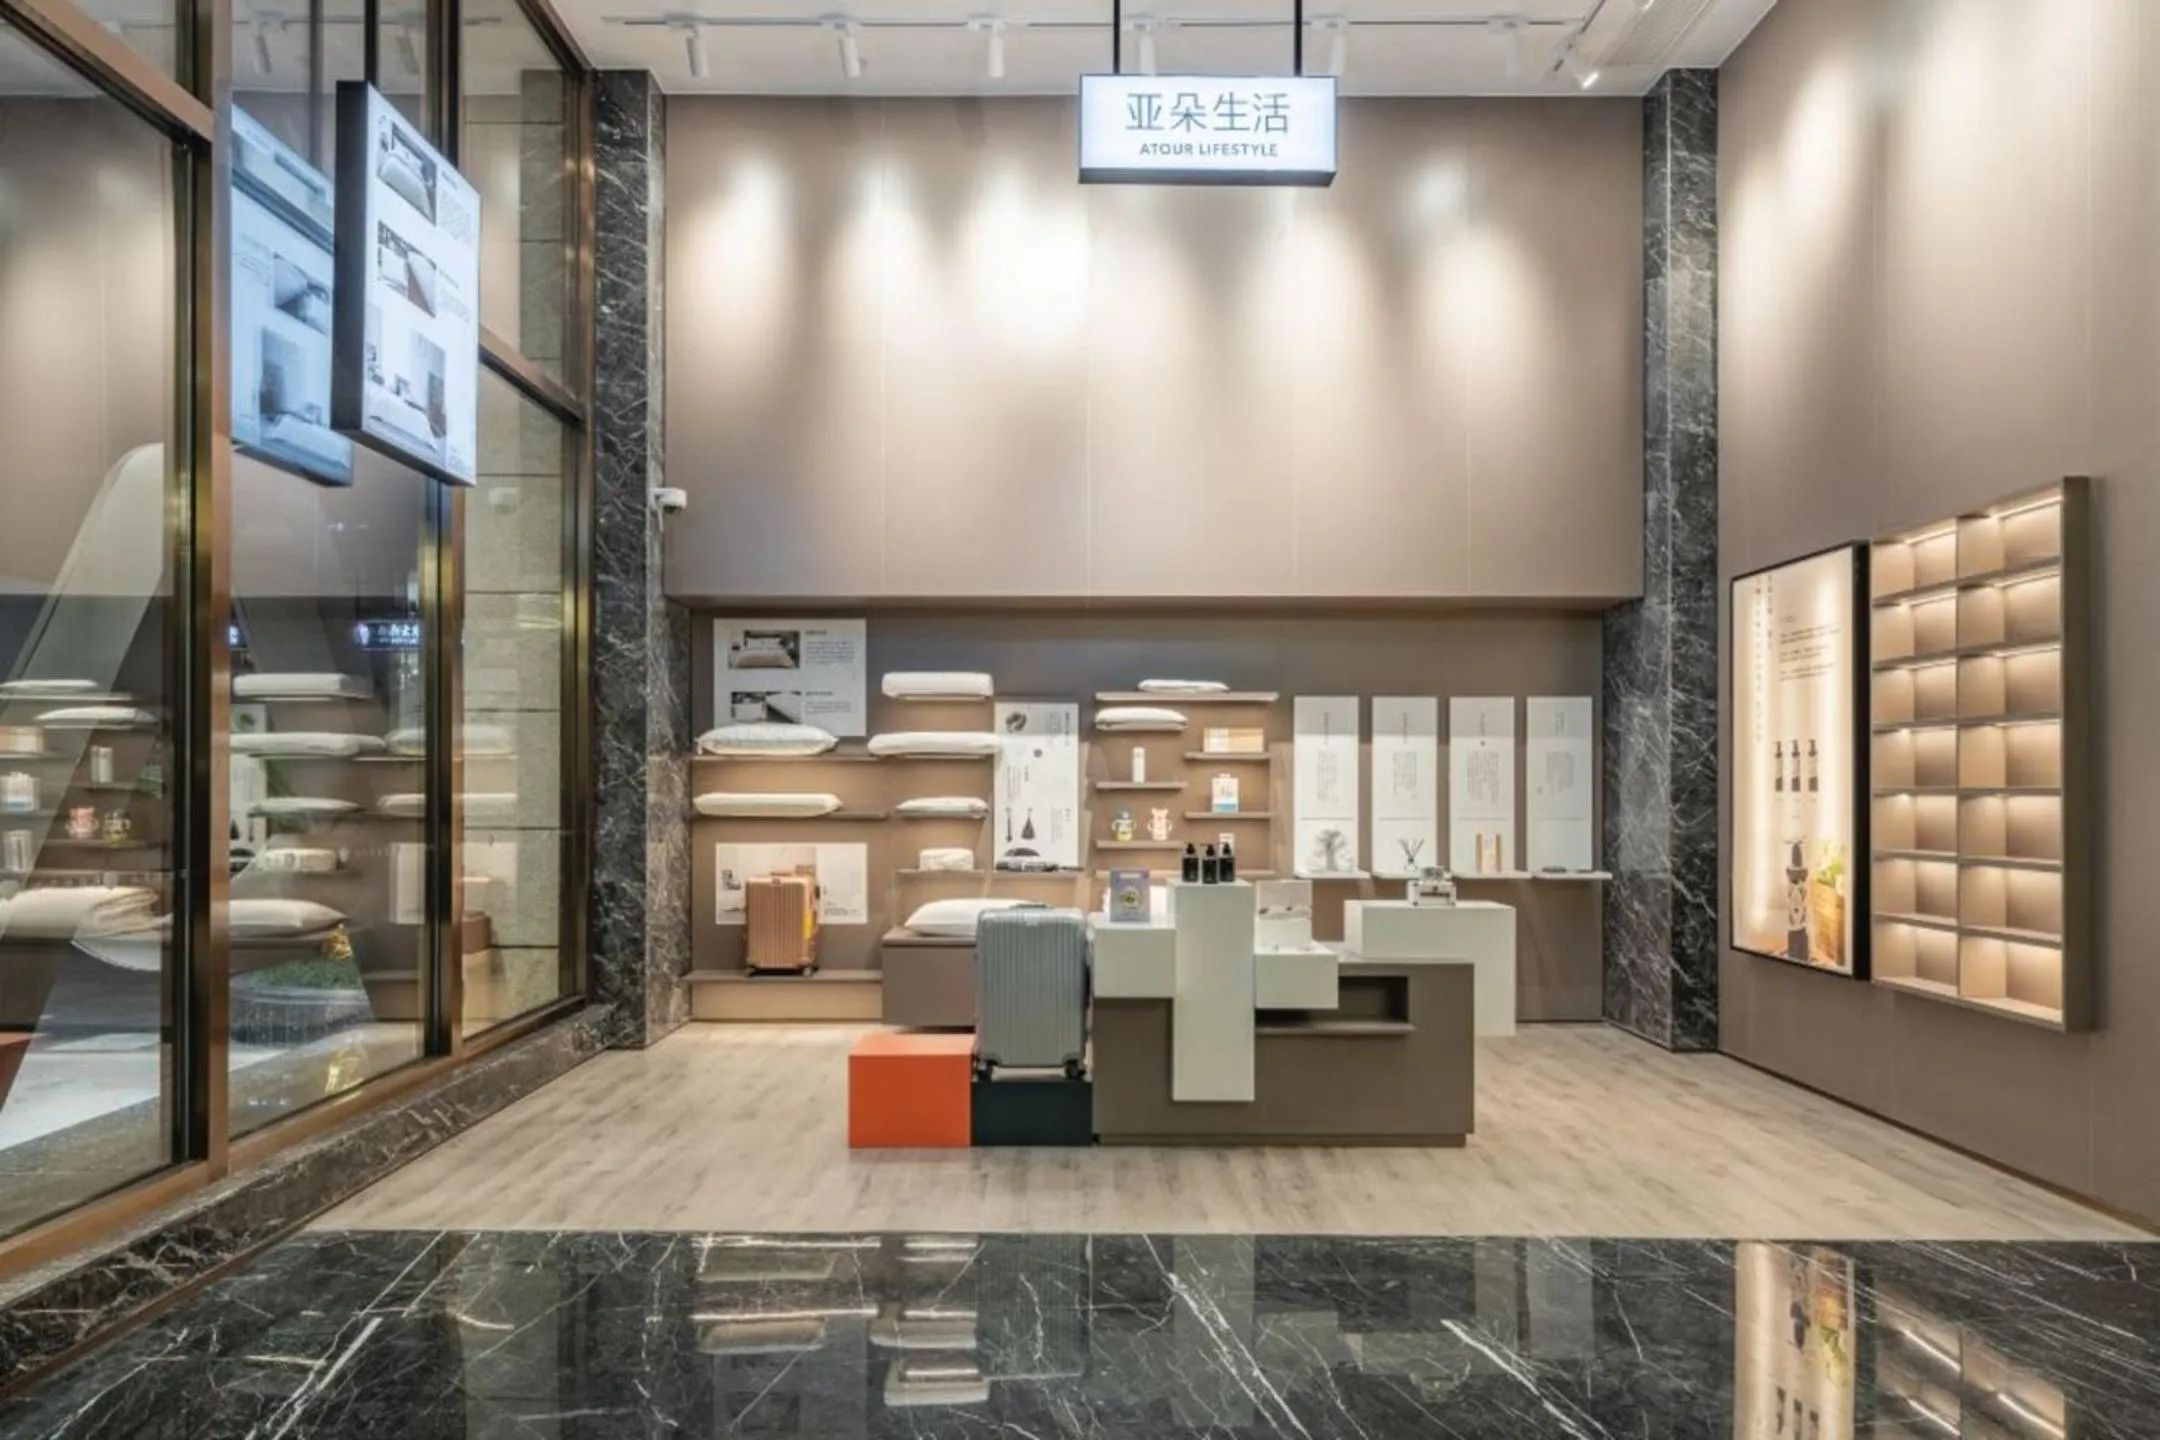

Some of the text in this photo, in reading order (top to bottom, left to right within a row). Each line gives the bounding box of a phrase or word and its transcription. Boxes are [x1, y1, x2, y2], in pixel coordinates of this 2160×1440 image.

[1126, 91, 1290, 134] 亚朵生活
[1139, 143, 1279, 157] ATOUR LIFESTYLE
